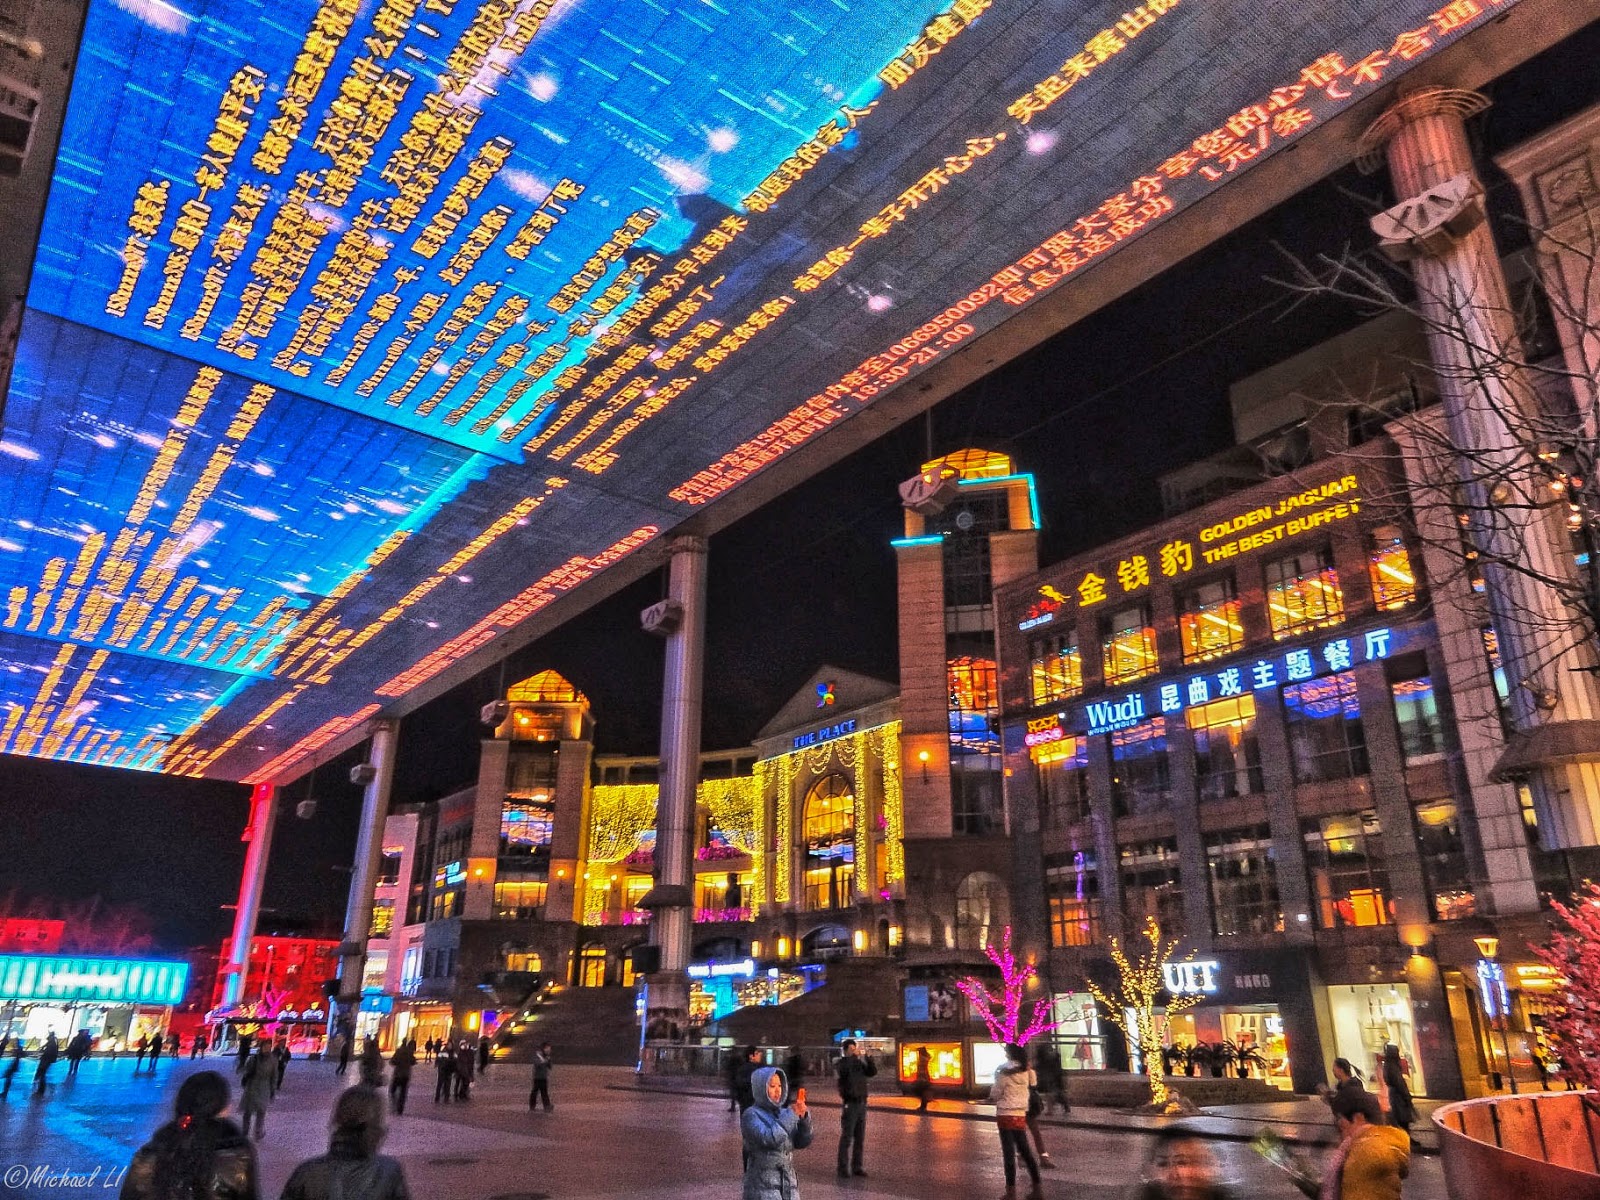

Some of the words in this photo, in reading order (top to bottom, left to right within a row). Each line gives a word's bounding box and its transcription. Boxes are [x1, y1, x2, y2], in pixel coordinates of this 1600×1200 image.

[1200, 505, 1271, 543] GOLDEN
[1274, 475, 1358, 516] JAGUAR
[1202, 544, 1238, 564] THE
[1239, 524, 1286, 553] BEST
[1287, 498, 1361, 537] BUFFET
[1077, 540, 1193, 607] 金钱豹
[1160, 629, 1390, 713] 昆曲戏主题餐厅
[794, 732, 815, 748] THE
[818, 719, 856, 741] PLACE
[1086, 693, 1145, 728] Wudi
